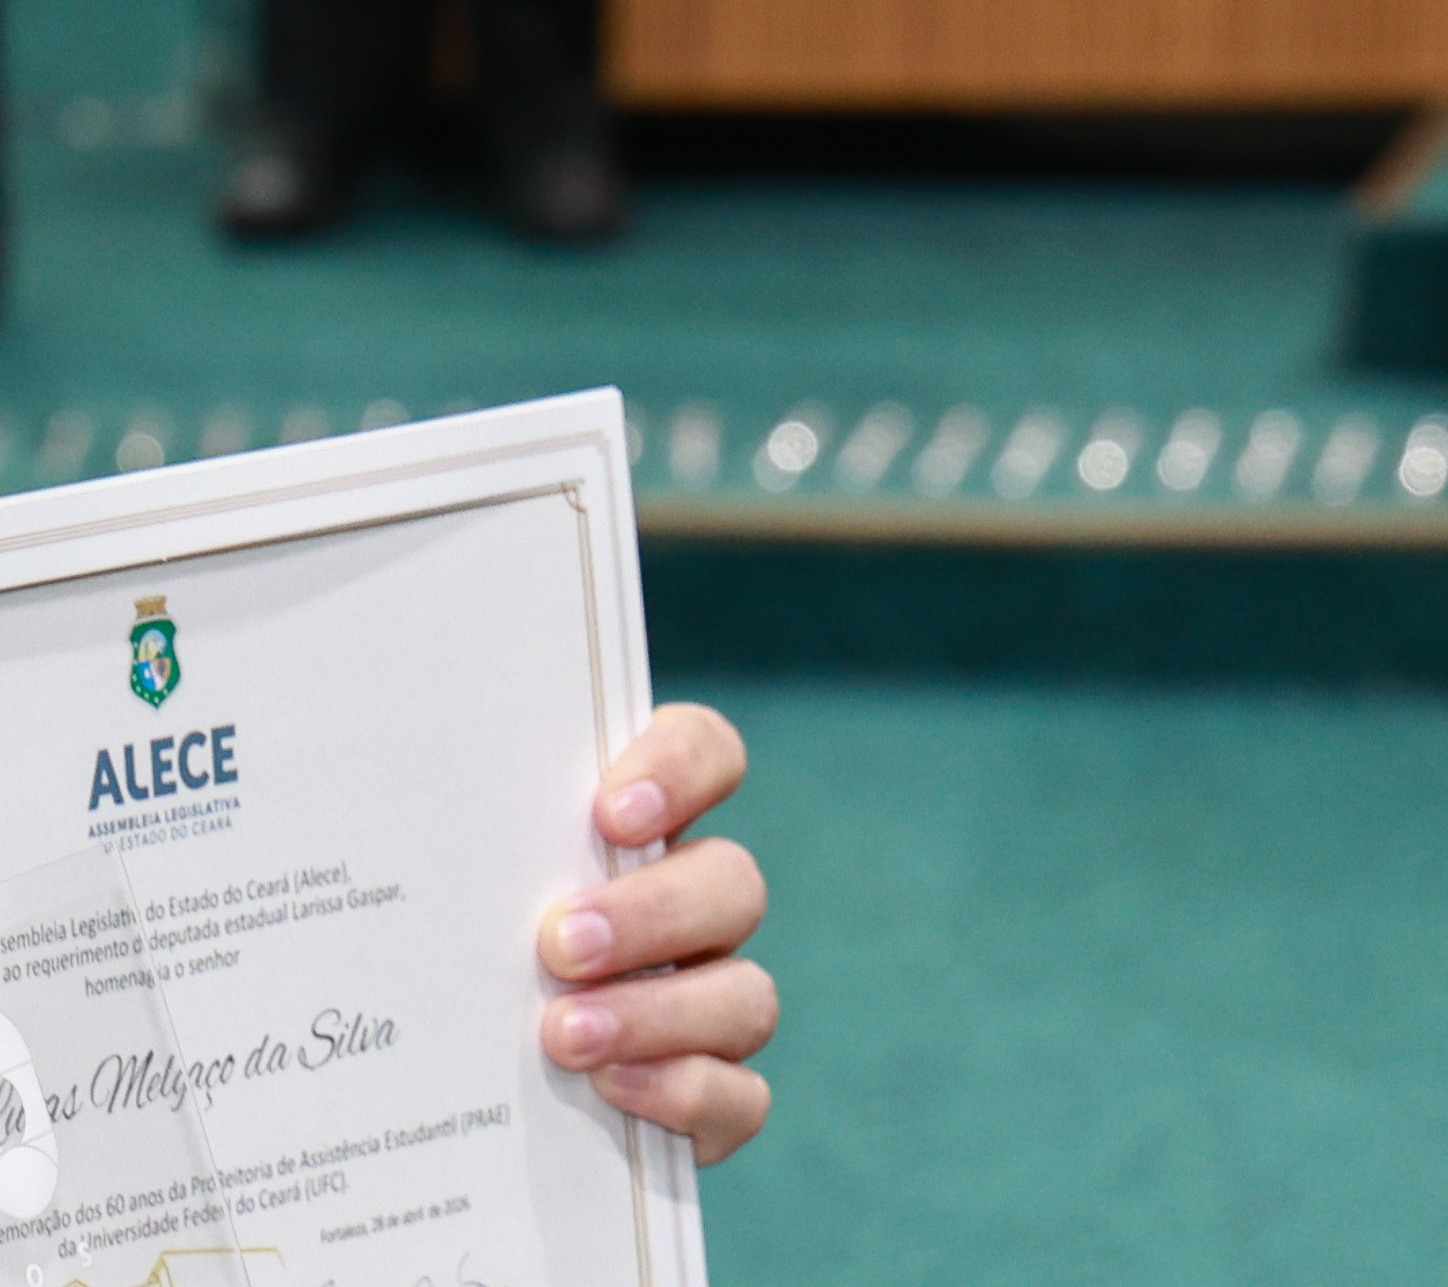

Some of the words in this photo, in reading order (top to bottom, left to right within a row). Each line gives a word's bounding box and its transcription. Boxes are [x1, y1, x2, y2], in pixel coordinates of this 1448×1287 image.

[88, 724, 238, 811] ALECE
[145, 899, 166, 923] do
[169, 886, 220, 918] Estado
[223, 884, 244, 906] do
[246, 871, 290, 901] Ceará
[2, 964, 22, 983] ao
[26, 940, 130, 978] requerimento
[149, 919, 221, 953] deputada
[224, 901, 289, 936] estadual
[292, 894, 344, 922] Larissa
[174, 961, 185, 980] o
[189, 948, 241, 976] senhor
[244, 1034, 292, 1080] da
[297, 1008, 400, 1072] Silva
[75, 1202, 102, 1225] dos
[105, 1194, 125, 1217] 60
[129, 1188, 164, 1212] anos
[168, 1179, 187, 1202] da
[277, 1154, 296, 1177] de
[300, 1135, 381, 1169] Assistência
[383, 1115, 457, 1152] Estudantil
[57, 1237, 76, 1259] da
[235, 1194, 255, 1216] do
[258, 1180, 302, 1209] Ceará
